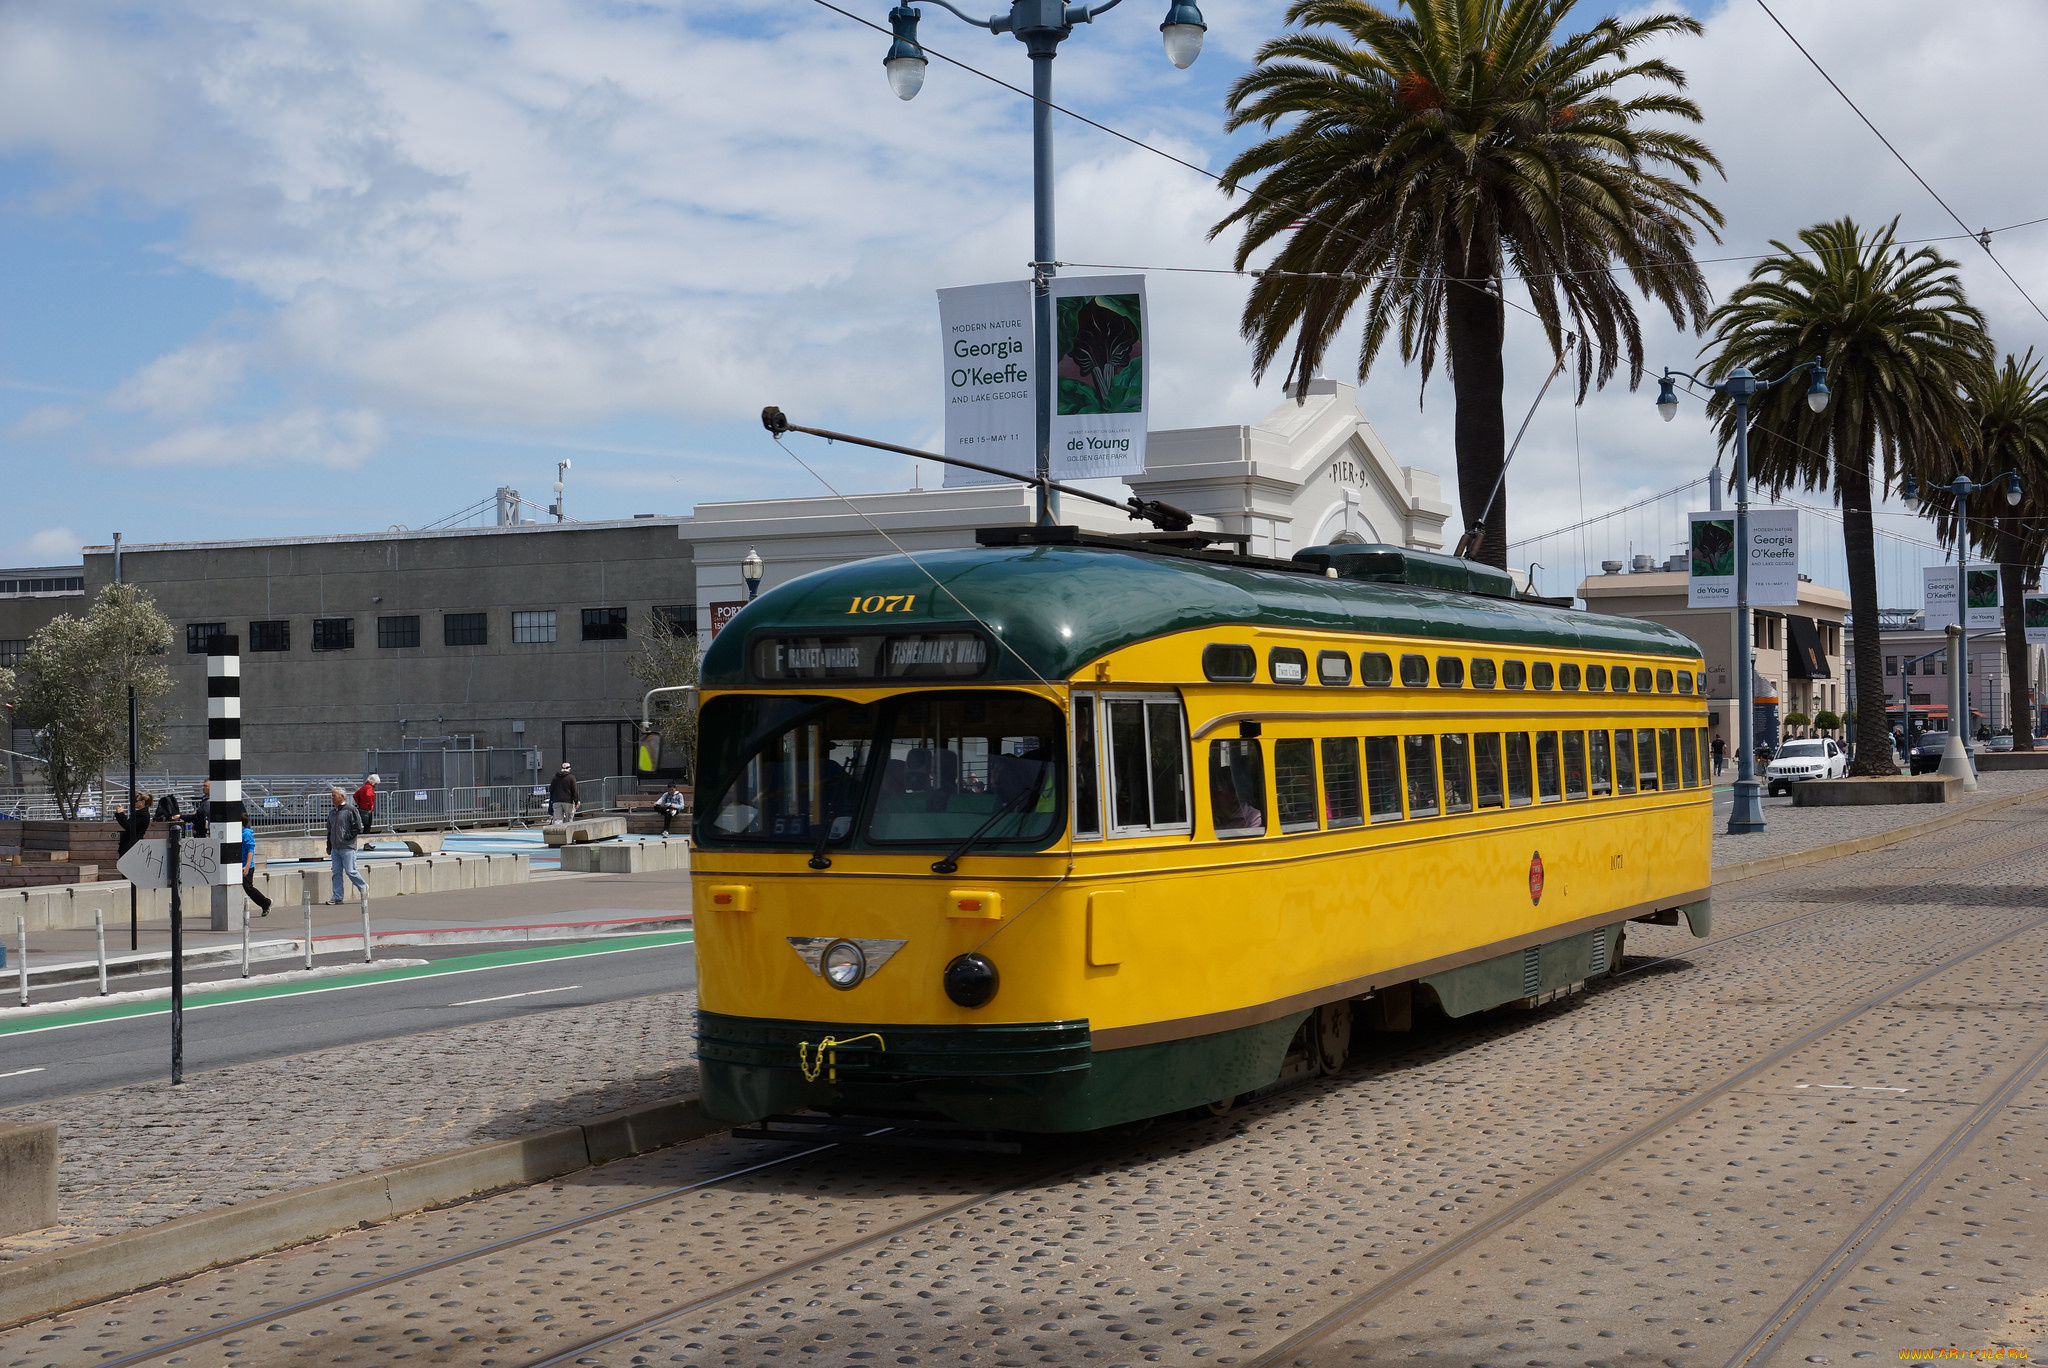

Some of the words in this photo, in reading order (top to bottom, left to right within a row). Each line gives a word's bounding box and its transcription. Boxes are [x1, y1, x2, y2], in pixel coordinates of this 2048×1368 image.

[952, 322, 987, 333] MODERN
[990, 320, 1022, 330] NATURE
[954, 336, 1023, 358] Georgia
[952, 364, 1028, 388] O'Keeffe
[952, 396, 968, 404] AND
[971, 394, 990, 402] LAKE
[992, 391, 1028, 401] GEORGE
[960, 436, 974, 445] FEB
[1067, 438, 1084, 450] de
[1086, 436, 1130, 452] Young
[1066, 454, 1092, 462] GOLDEN
[1754, 534, 1792, 546] Georgia
[1752, 548, 1795, 558] O'Keeffe
[845, 594, 916, 614] 1071
[776, 645, 784, 672] F
[892, 641, 953, 664] FISHERMAN'S
